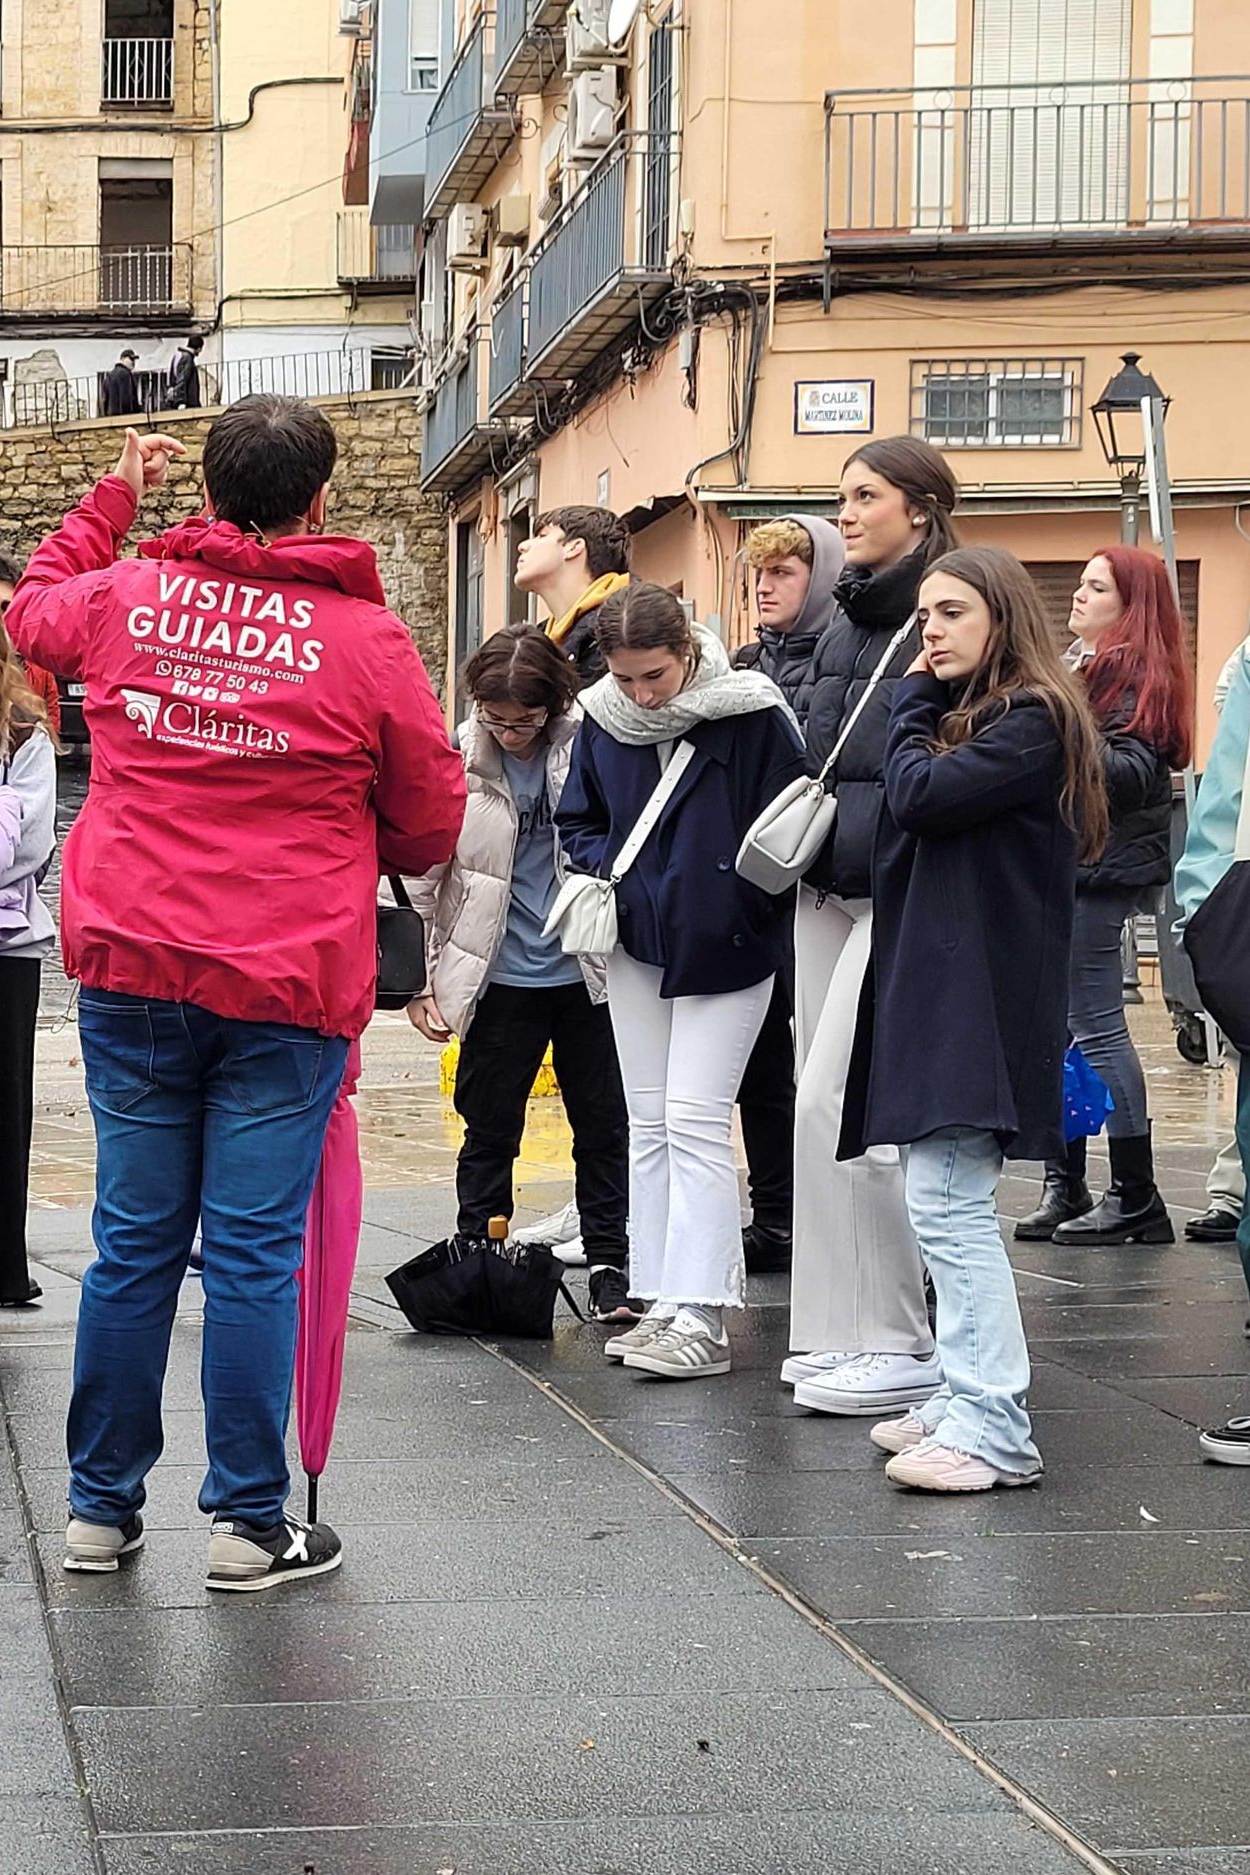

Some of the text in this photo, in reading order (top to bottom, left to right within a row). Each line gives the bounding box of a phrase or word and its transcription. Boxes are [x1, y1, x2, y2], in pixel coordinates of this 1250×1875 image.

[822, 391, 859, 404] CALLE
[159, 573, 315, 629] VISITAS
[127, 606, 324, 672] GUIADAS
[134, 642, 304, 684] www.claritasturismo.com
[204, 670, 225, 685] 77
[226, 675, 246, 690] 50
[249, 679, 269, 694] 43
[163, 702, 290, 753] Cláritas
